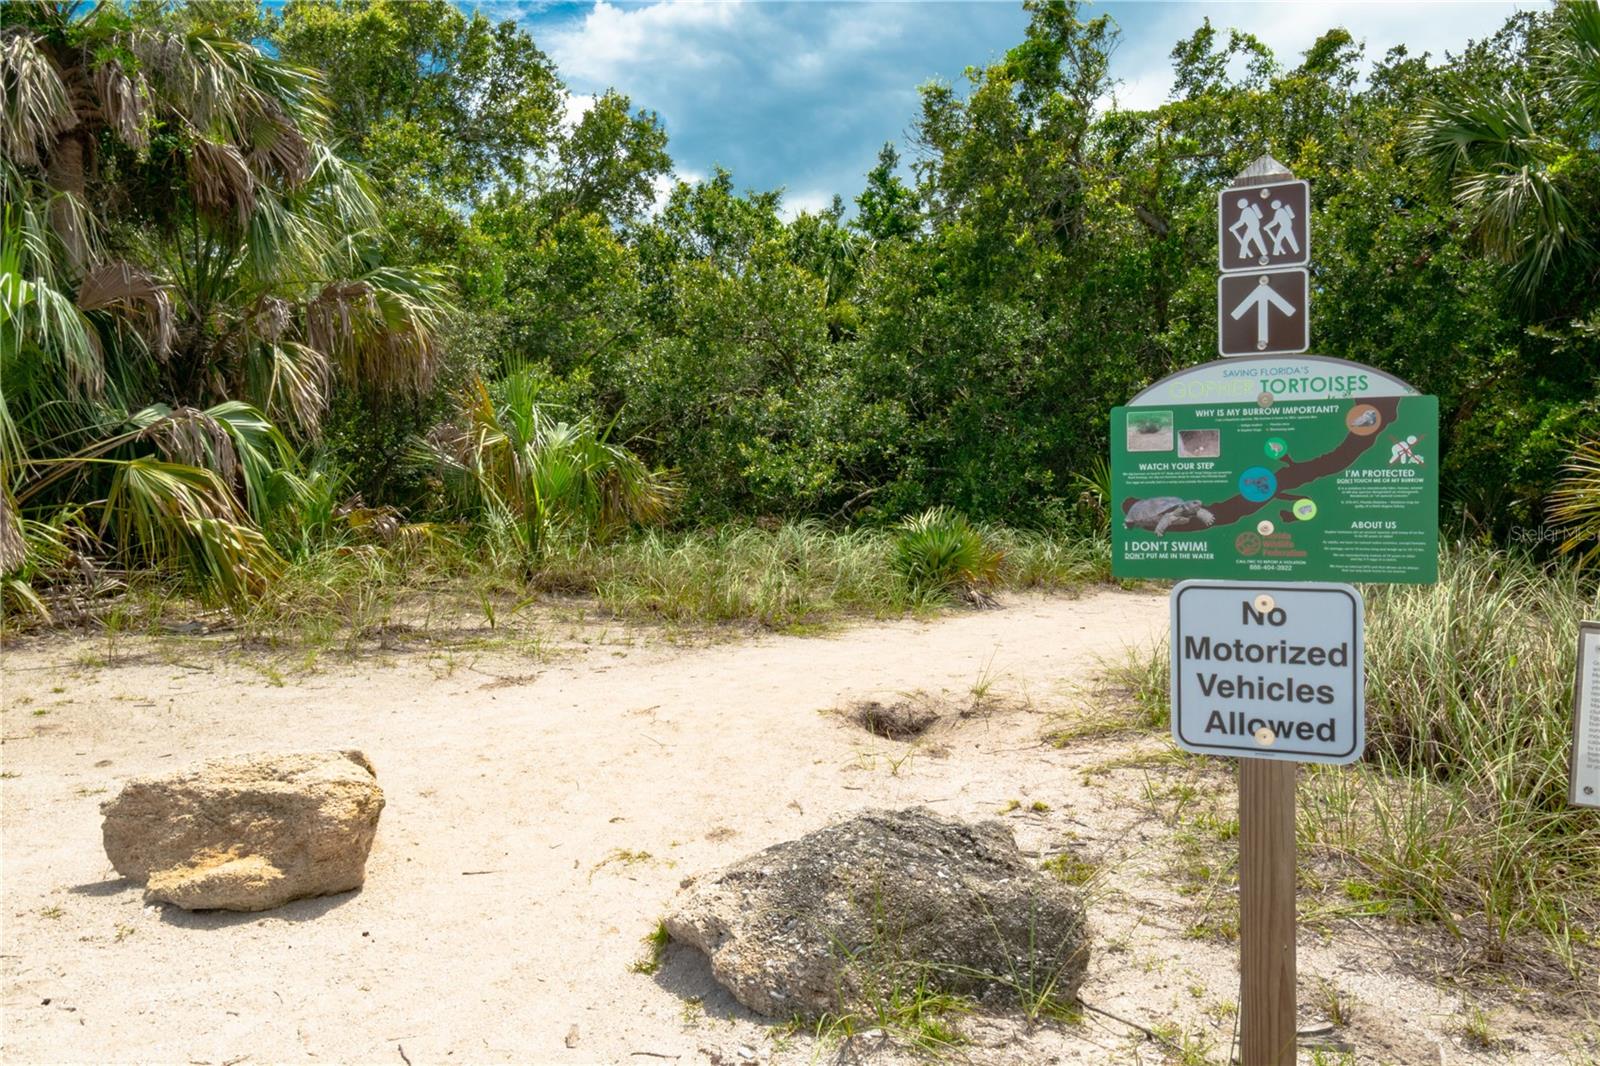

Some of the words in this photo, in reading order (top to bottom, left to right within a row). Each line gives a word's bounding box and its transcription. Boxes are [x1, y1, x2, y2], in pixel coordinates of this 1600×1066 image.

[1223, 368, 1258, 378] SAVING
[1260, 366, 1310, 376] FLORIDA'S
[1260, 374, 1369, 394] TORTOISES
[1195, 409, 1214, 417] WHY
[1217, 408, 1224, 417] IS
[1226, 408, 1241, 416] MY
[1242, 406, 1281, 416] BURROW
[1282, 404, 1339, 415] IMPORTANT?
[1139, 462, 1169, 471] WATCH
[1172, 462, 1195, 470] YOUR
[1345, 470, 1360, 478] I'M
[1362, 469, 1415, 478] PROTECTED
[1351, 521, 1382, 530] ABOUT
[1385, 521, 1397, 530] US
[1124, 542, 1128, 551] I
[1132, 541, 1168, 552] DON'T
[1171, 541, 1208, 552] SWIM!
[1242, 600, 1287, 627] No
[1185, 636, 1348, 667] Motorized
[1196, 672, 1335, 705] Vehicles
[1204, 709, 1336, 742] Allowed
